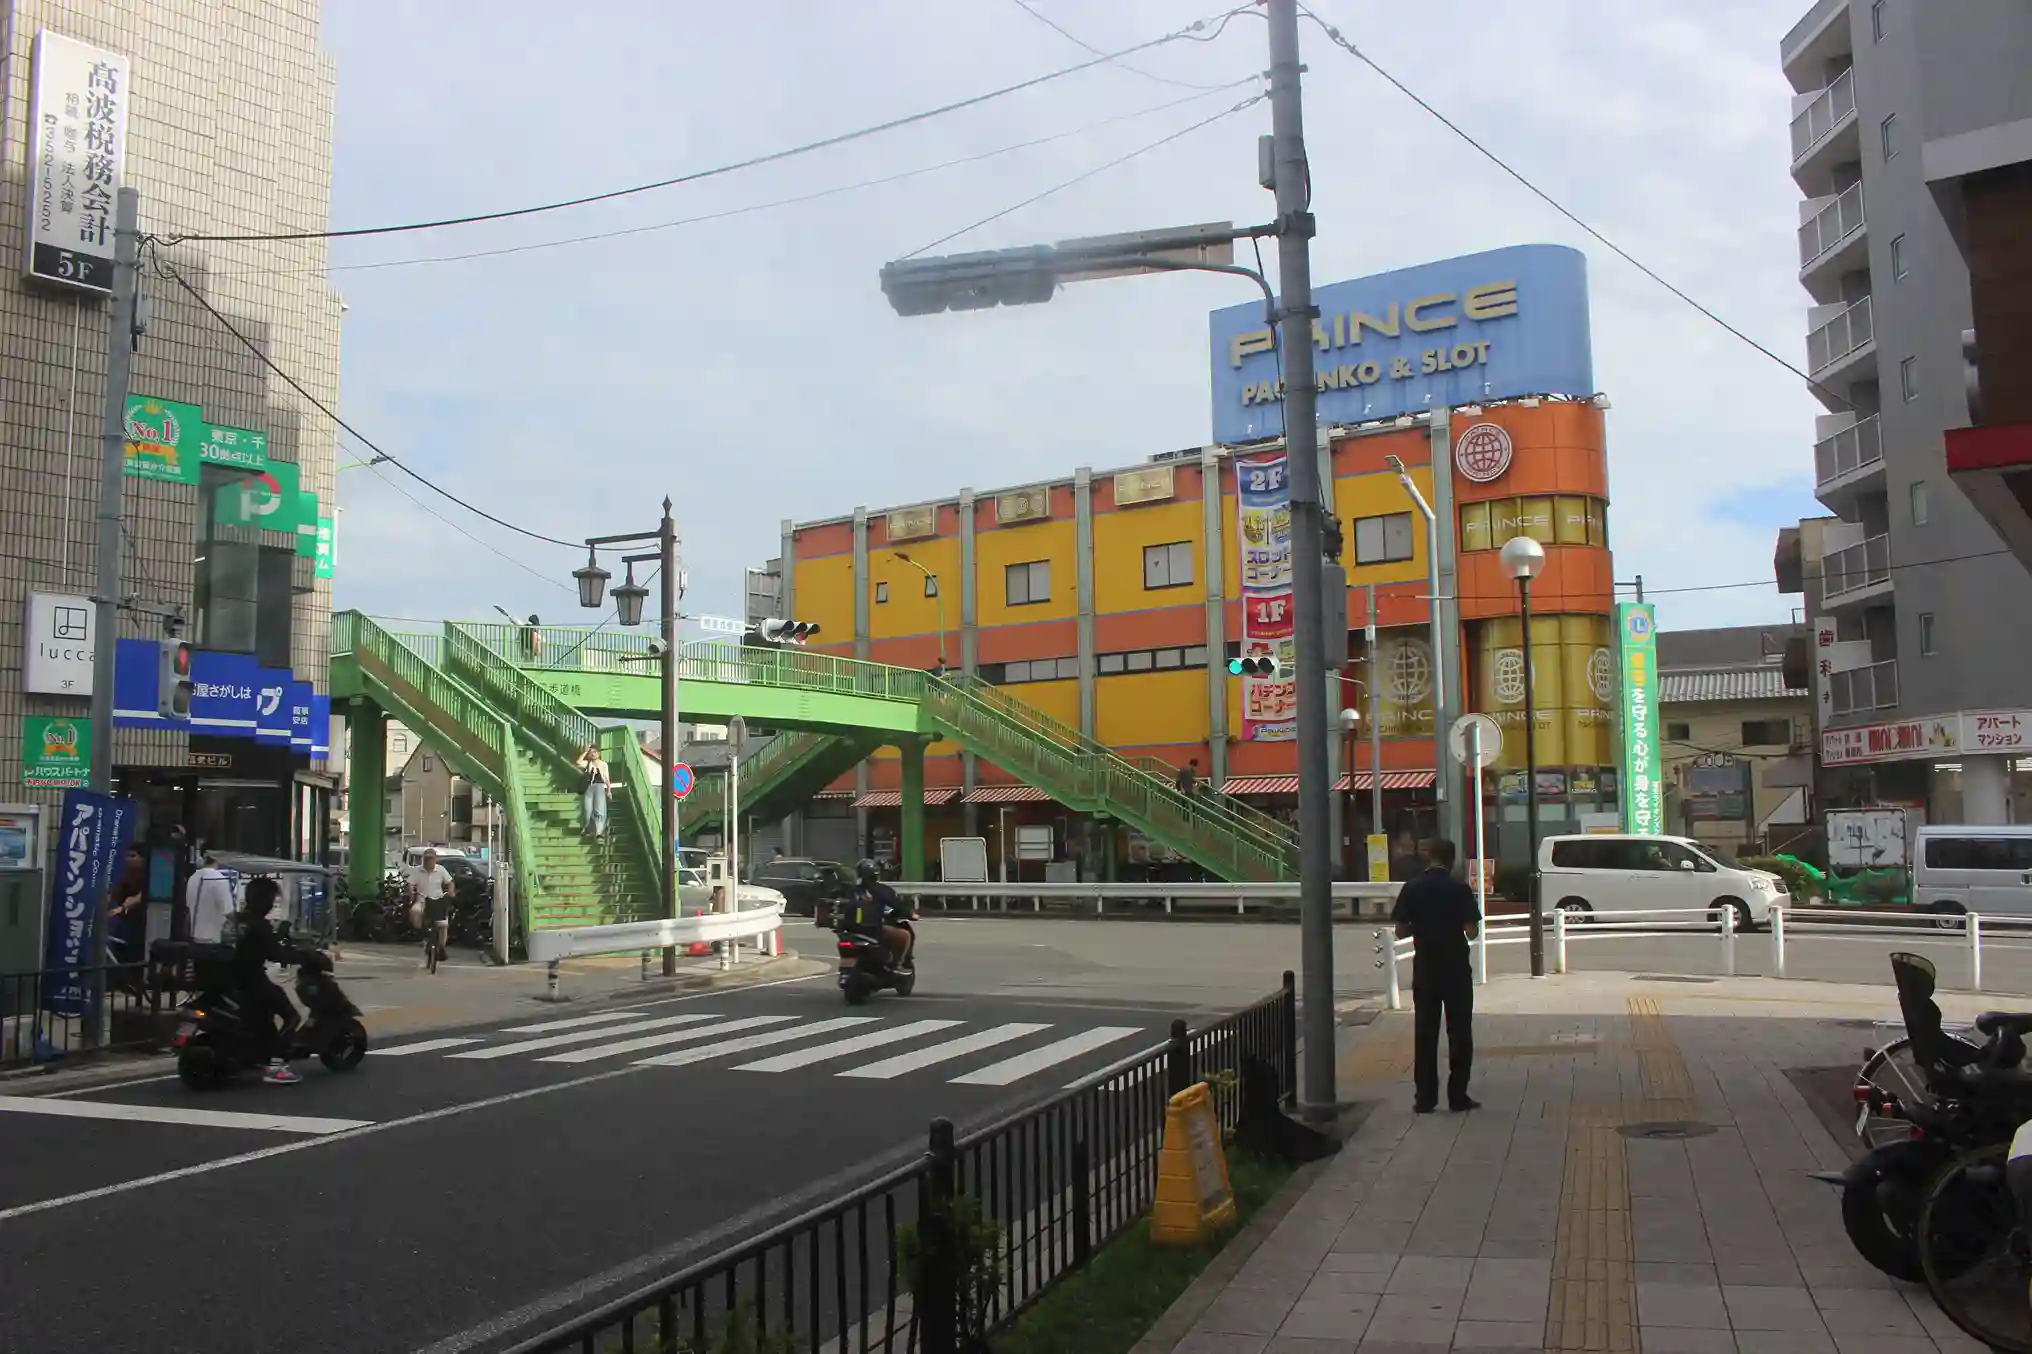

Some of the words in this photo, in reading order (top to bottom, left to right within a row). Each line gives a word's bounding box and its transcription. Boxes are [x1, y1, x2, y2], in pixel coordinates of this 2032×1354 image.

[58, 252, 93, 281] 5F
[1230, 279, 1519, 370] PINCE
[1242, 361, 1380, 407] PACNKO
[1390, 357, 1415, 381] &
[1421, 340, 1491, 375] SLOT
[1250, 468, 1284, 491] 2F
[1256, 600, 1287, 624] 1F
[61, 680, 75, 689] 3F
[1976, 716, 2021, 730] アパート
[1977, 733, 2022, 746] マンション
